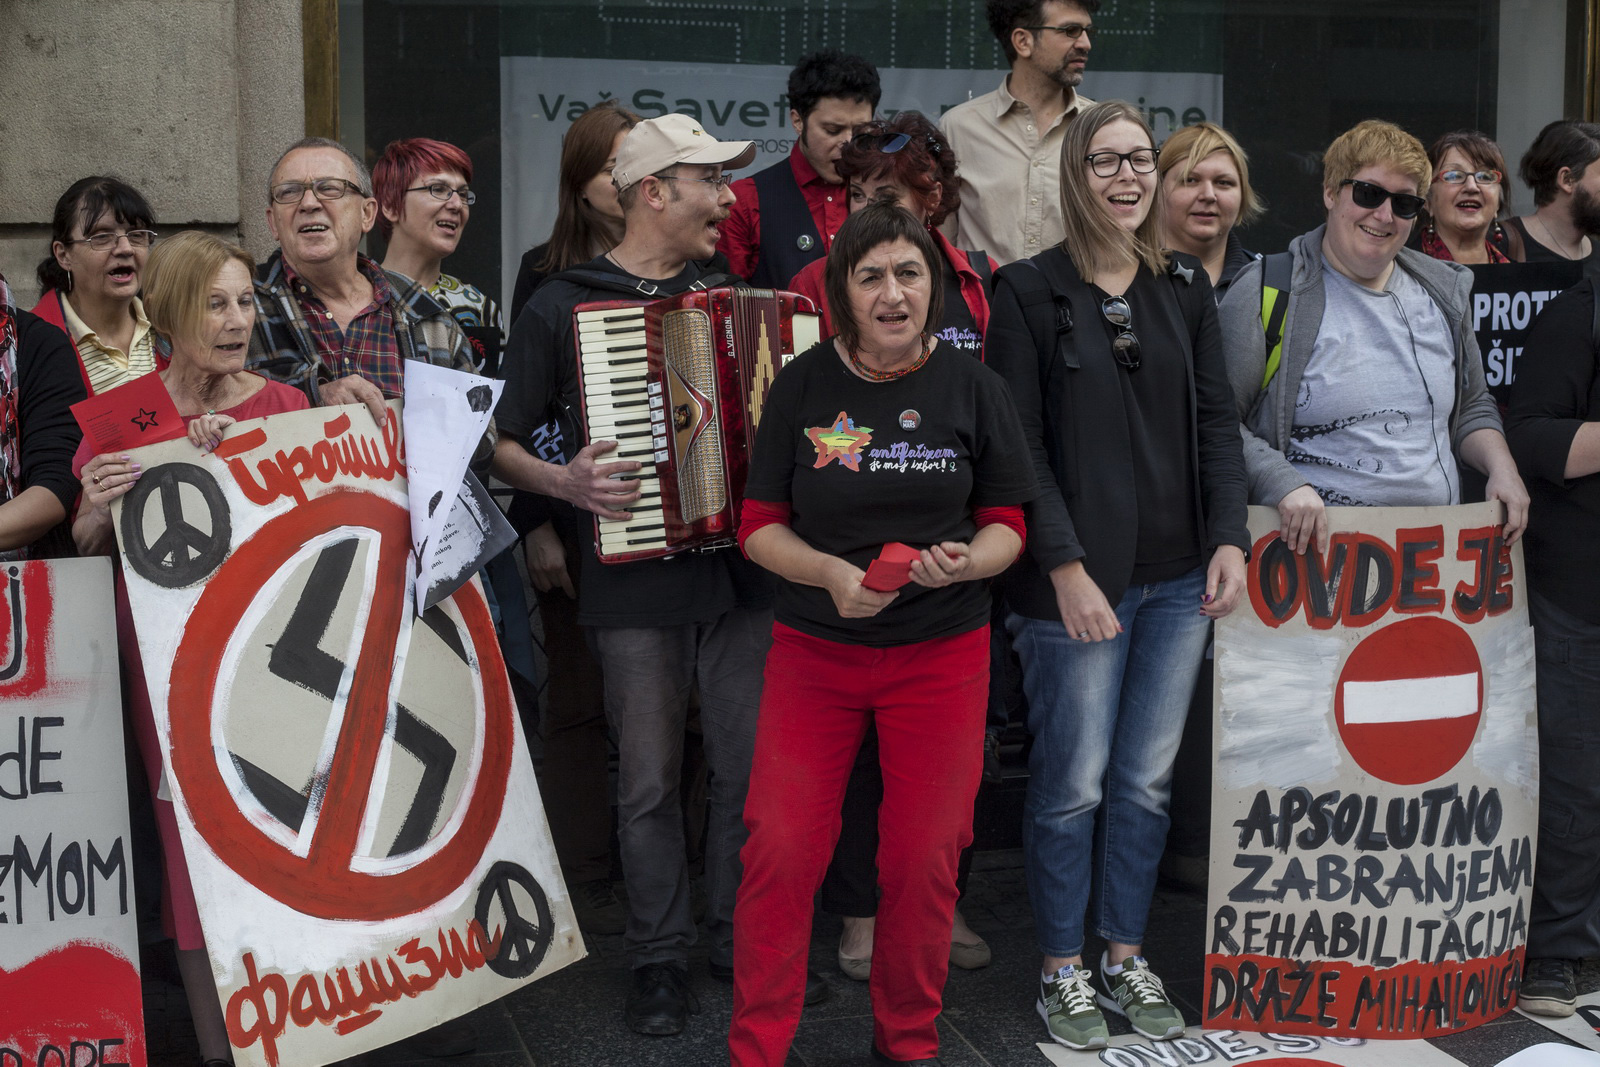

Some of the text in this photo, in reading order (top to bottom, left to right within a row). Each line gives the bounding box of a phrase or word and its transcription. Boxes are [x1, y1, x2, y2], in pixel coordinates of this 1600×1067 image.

[538, 93, 612, 123] Va
[632, 88, 790, 128] Savet
[1482, 339, 1524, 387] ŠI
[1247, 525, 1514, 629] OVDE JE
[1233, 783, 1503, 854] APSOLUTNO
[1211, 897, 1527, 967] REHABILITACIJA
[1207, 960, 1341, 1029] DRAŽE
